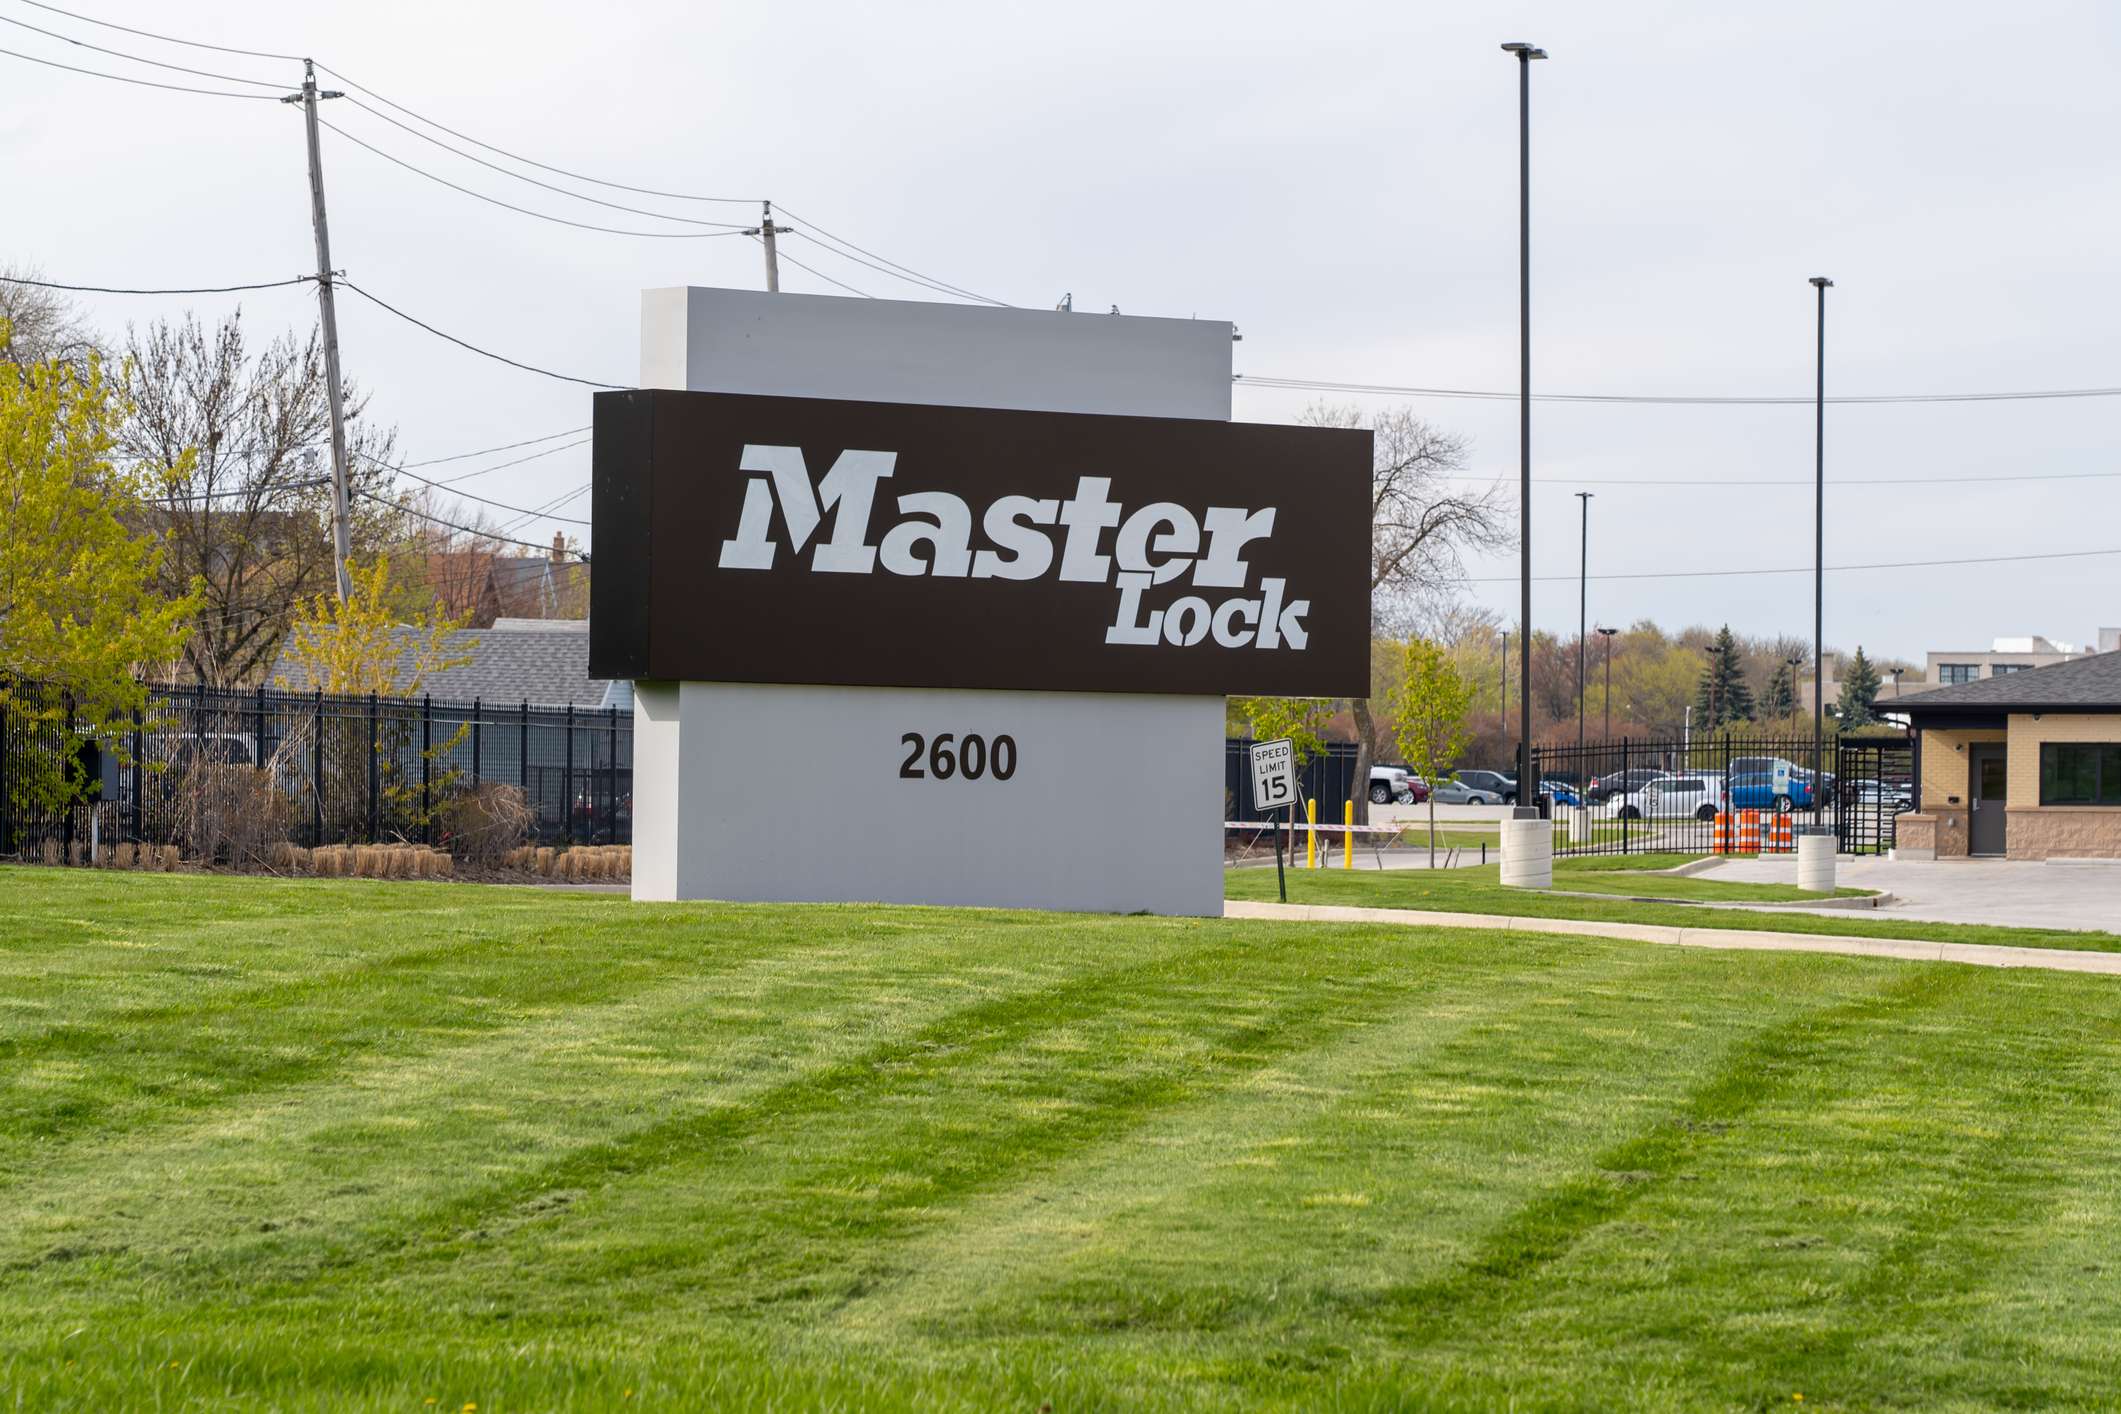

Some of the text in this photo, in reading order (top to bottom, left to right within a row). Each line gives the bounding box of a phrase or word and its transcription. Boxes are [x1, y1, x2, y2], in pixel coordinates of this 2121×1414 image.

[717, 443, 1277, 588] Master
[1105, 572, 1311, 650] Lock
[899, 732, 1018, 781] 2600
[1255, 746, 1289, 761] SPEED
[1259, 761, 1286, 774] LIMIT
[1262, 775, 1288, 801] 15
